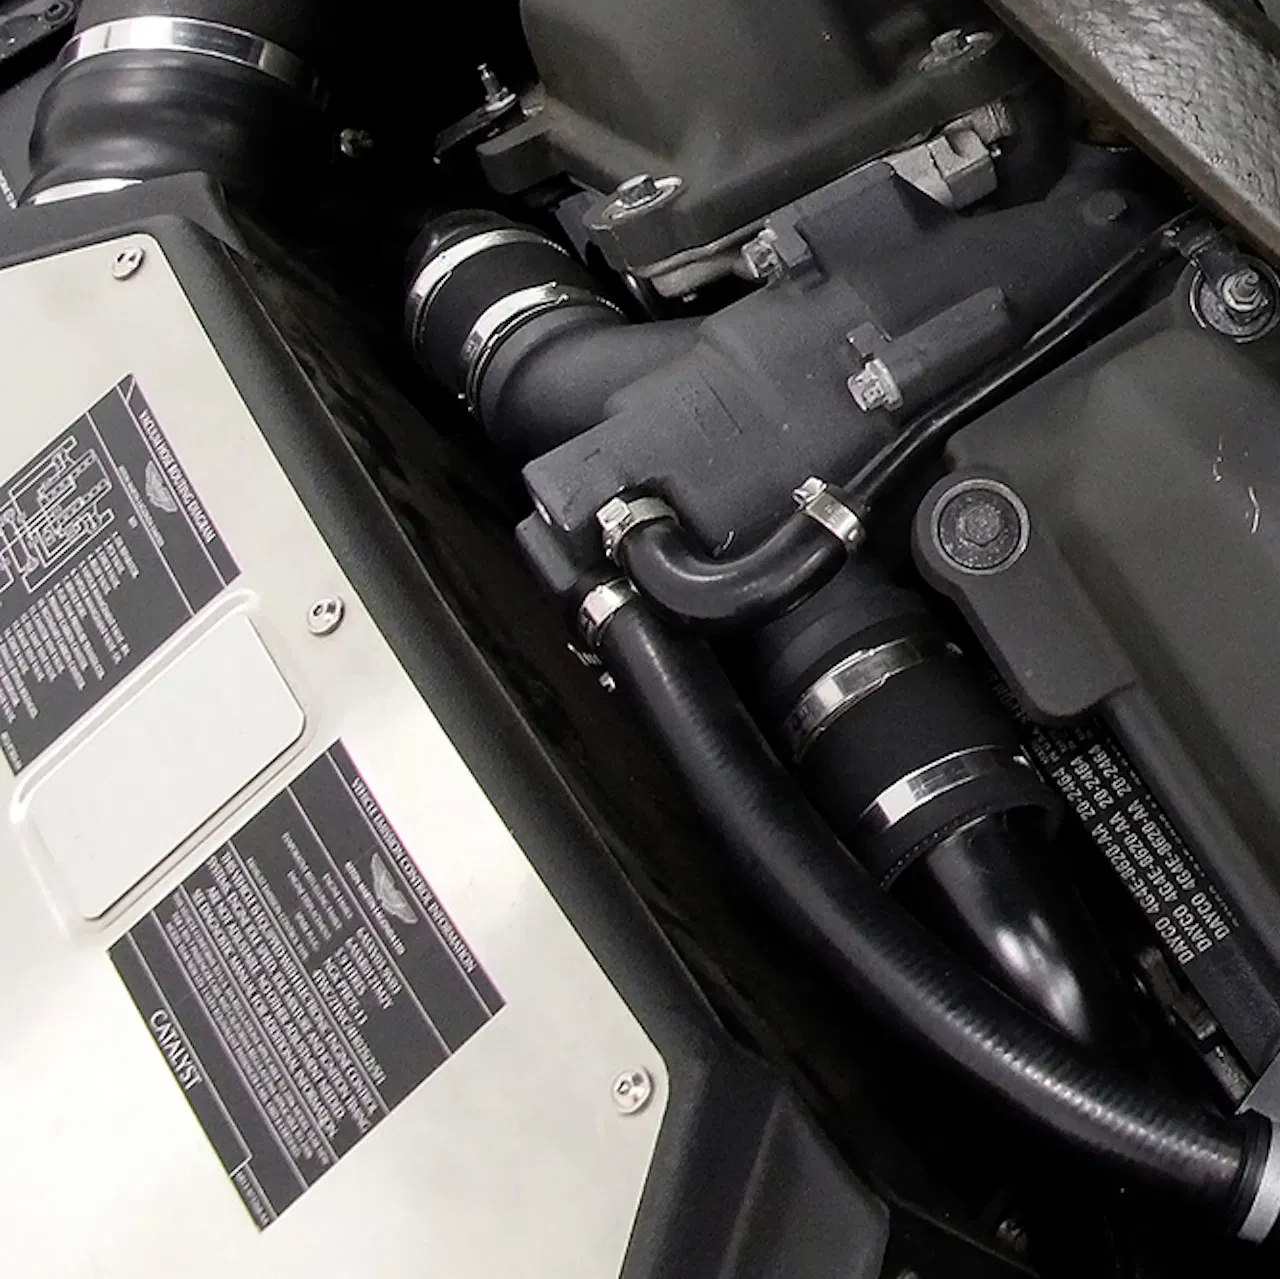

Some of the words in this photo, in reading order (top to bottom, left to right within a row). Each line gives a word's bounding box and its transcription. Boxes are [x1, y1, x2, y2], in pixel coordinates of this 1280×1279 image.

[1048, 764, 1098, 825] 20-2464
[1065, 752, 1115, 812] 20-2464
[1084, 739, 1133, 799] 20-2464
[1087, 820, 1163, 919] 4G4E-8620-AA
[1104, 807, 1181, 906] 4G4E-8620-AA
[1123, 795, 1199, 894] 4G4E-8620-AA
[397, 853, 436, 909] CONTROL
[426, 899, 478, 975] INFORMATION
[1151, 912, 1197, 967] DAYCO
[1169, 900, 1215, 954] DAYCO
[1187, 887, 1233, 941] DAYCO
[146, 1004, 203, 1095] CATALYST
